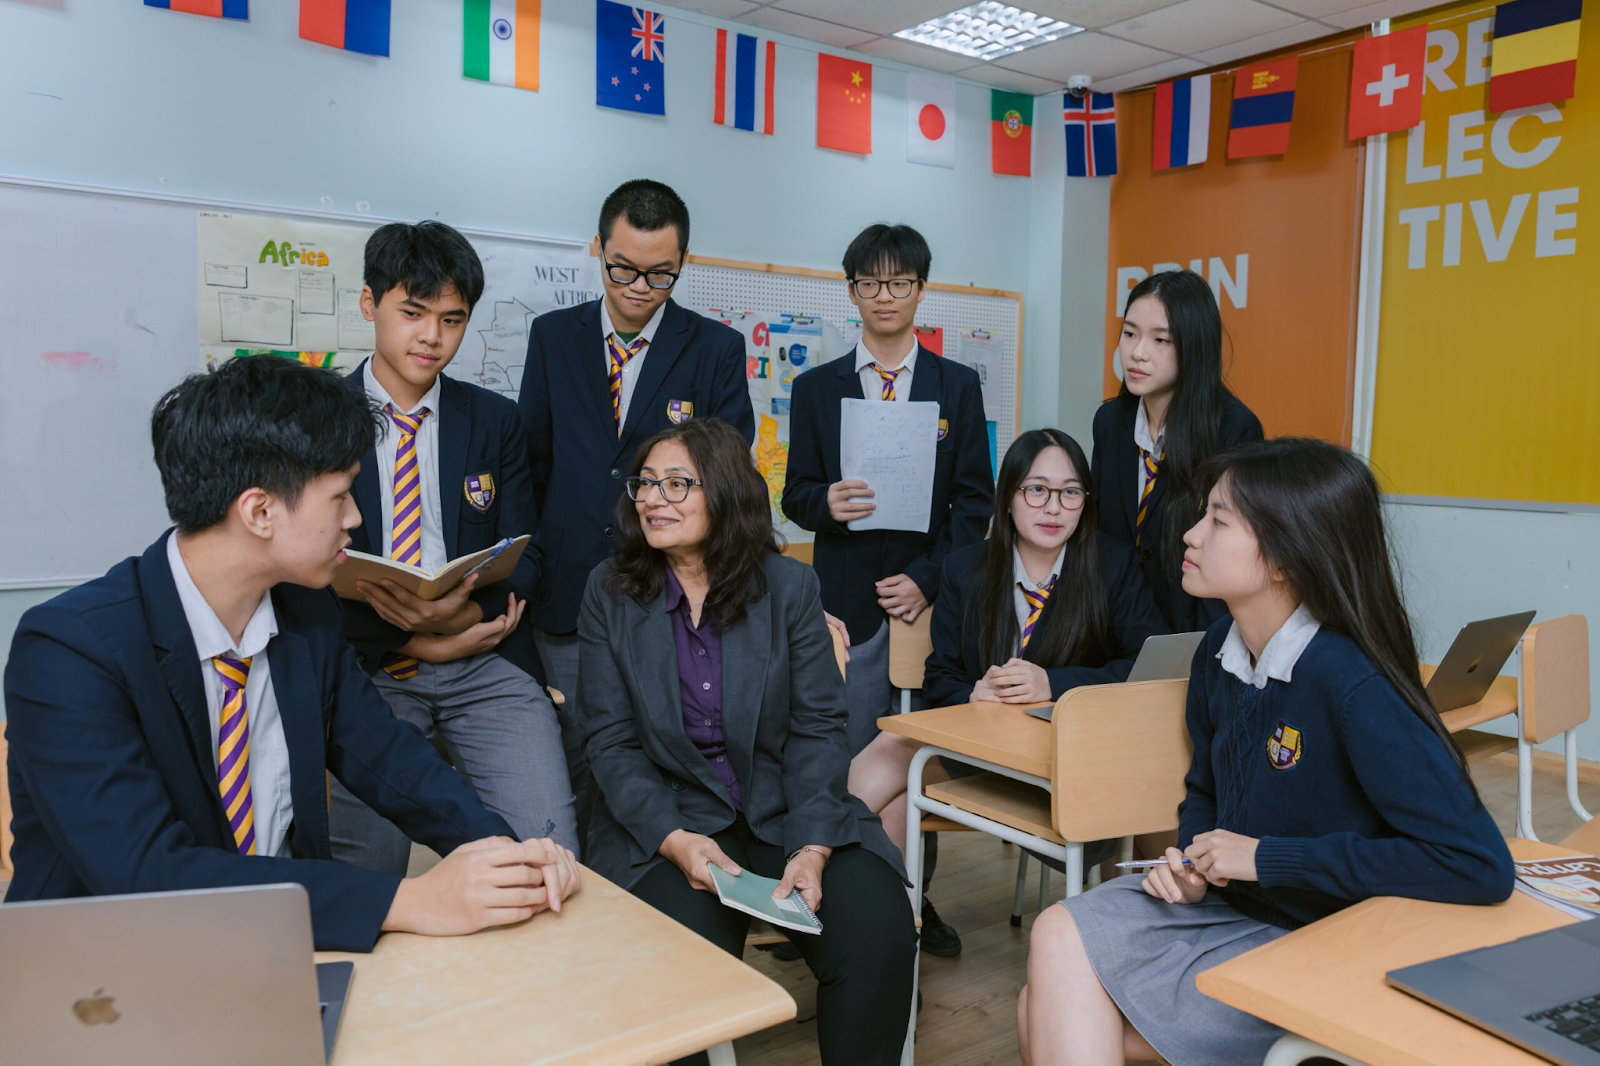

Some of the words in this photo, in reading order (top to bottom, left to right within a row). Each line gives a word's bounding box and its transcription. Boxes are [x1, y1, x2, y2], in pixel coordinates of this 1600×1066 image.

[1406, 102, 1563, 184] LEC
[259, 240, 329, 267] Africa
[1398, 186, 1580, 270] TIVE
[535, 265, 579, 284] WEST
[1116, 253, 1249, 318] PN
